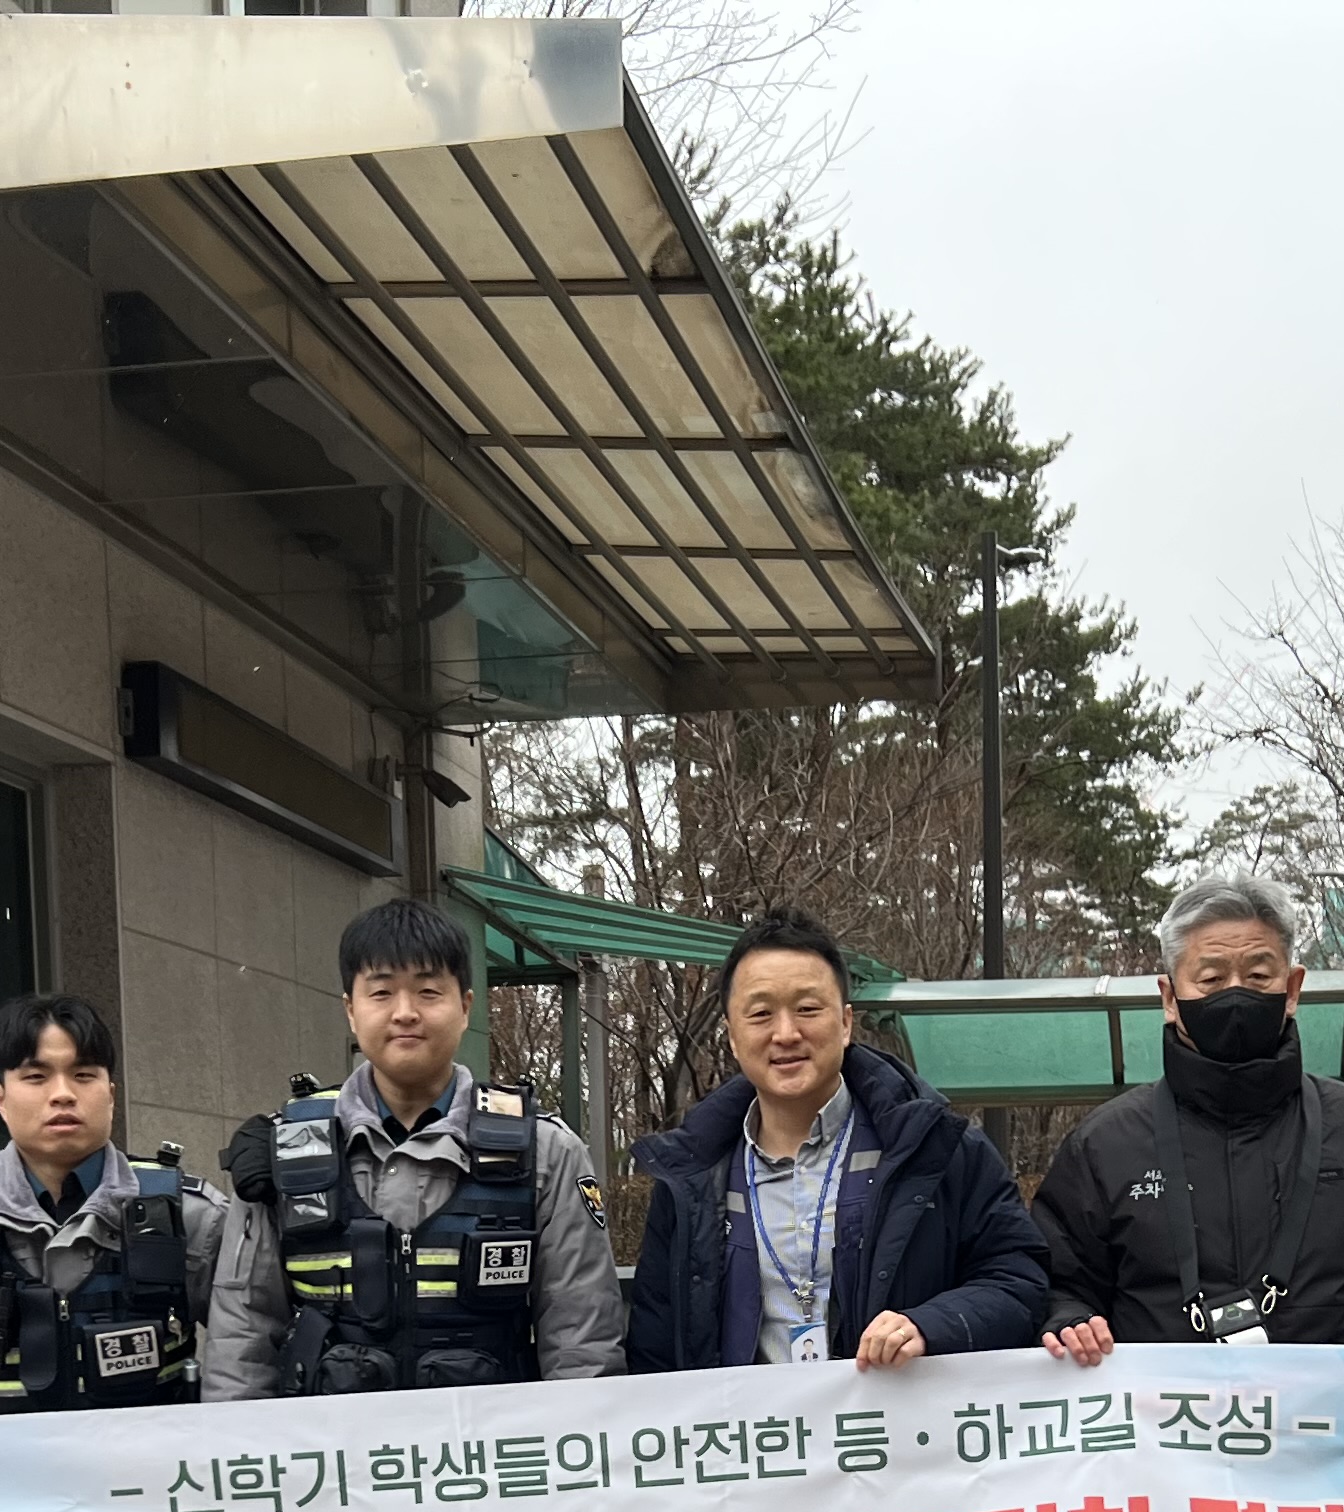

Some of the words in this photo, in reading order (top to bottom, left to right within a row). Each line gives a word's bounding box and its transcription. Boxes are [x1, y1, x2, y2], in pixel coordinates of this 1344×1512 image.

[486, 1269, 524, 1280] POLICE
[106, 1356, 152, 1371] POLICE
[369, 1432, 611, 1508] 학생들의
[632, 1416, 812, 1488] 안전한
[833, 1411, 891, 1473] 등
[953, 1394, 1137, 1468] 하교길
[1158, 1392, 1274, 1456] 조성
